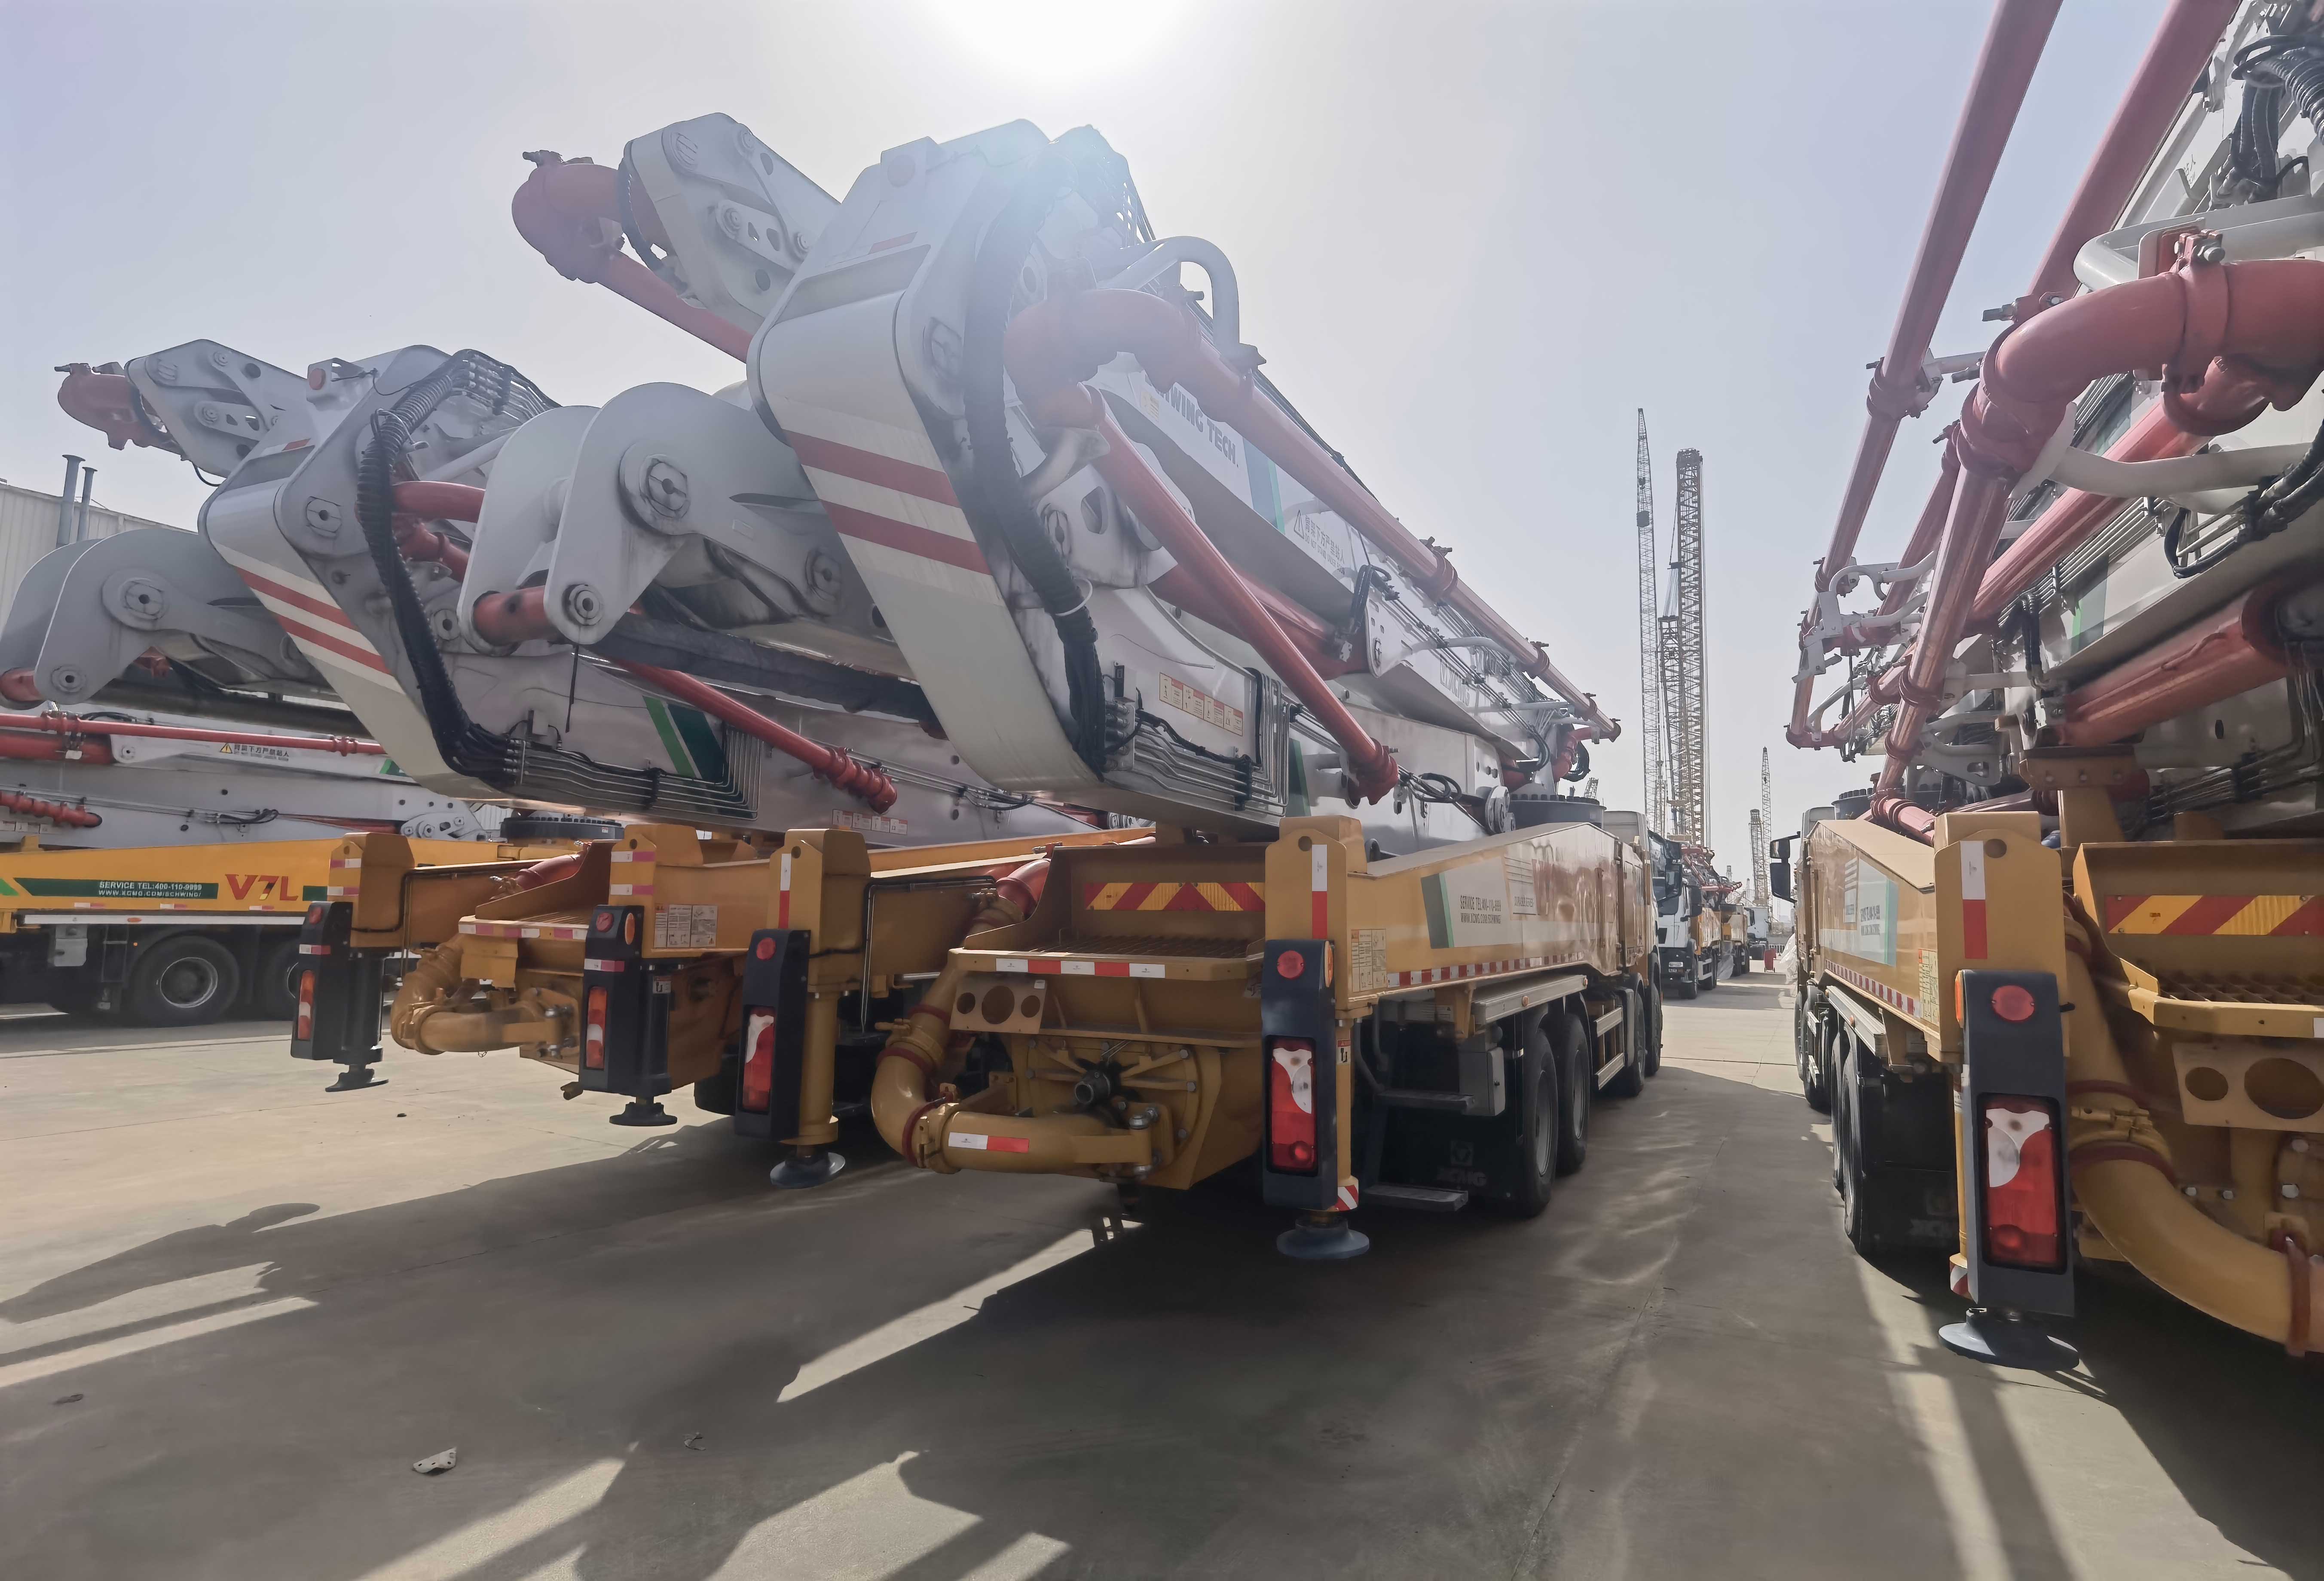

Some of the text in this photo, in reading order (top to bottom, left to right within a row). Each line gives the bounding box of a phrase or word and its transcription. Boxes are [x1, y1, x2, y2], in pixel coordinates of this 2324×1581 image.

[99, 881, 135, 889] SERVICE
[224, 873, 299, 901] V7L
[1460, 894, 1475, 910] SERVICE
